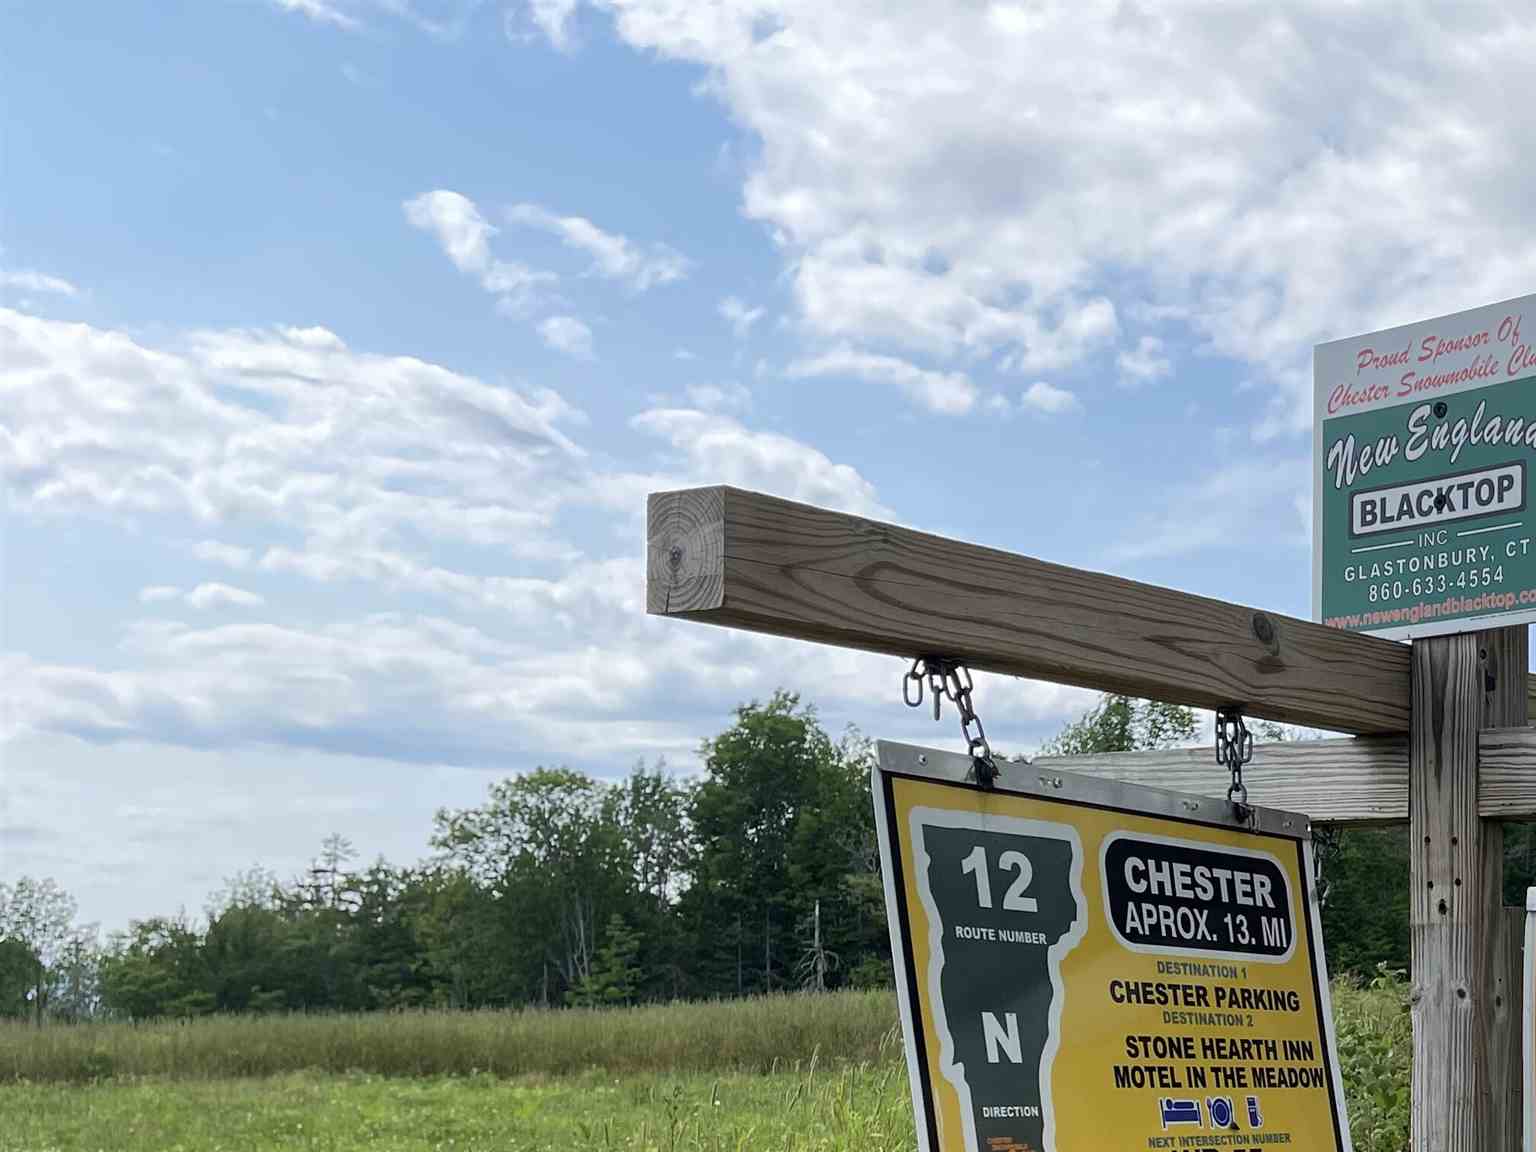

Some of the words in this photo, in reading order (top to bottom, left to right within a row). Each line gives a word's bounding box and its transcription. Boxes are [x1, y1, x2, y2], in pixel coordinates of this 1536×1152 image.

[1357, 341, 1411, 375] Proud
[1418, 330, 1489, 365] Sponsor
[1497, 314, 1522, 346] Of
[1328, 383, 1390, 414] Chester
[1397, 353, 1498, 397] Snowmobile
[1327, 432, 1400, 489] New
[1360, 474, 1514, 527] BLACKTOP
[1417, 530, 1448, 547] INC
[1344, 545, 1495, 582] GLASTONBURY,
[1506, 539, 1530, 557] CT
[1368, 566, 1503, 602] 860-633-4554
[961, 846, 1038, 912] 12
[1124, 856, 1276, 908] CHESTER
[955, 926, 996, 941] ROUTE
[998, 930, 1047, 945] NUMBER
[1125, 901, 1217, 942] APROX.
[1224, 913, 1256, 945] 13.
[1261, 916, 1287, 948] MI
[1157, 960, 1238, 978] DESTINATION
[1241, 967, 1248, 979] 1
[1110, 980, 1210, 1008] CHESTER
[1215, 986, 1300, 1012] PARKING
[1163, 1011, 1243, 1026] DESTINATION
[1246, 1014, 1254, 1027] 2
[981, 1011, 1023, 1064] N
[1126, 1035, 1197, 1059] STONE
[1201, 1038, 1278, 1060] HEARTH
[1283, 1040, 1315, 1061] INN
[1113, 1065, 1182, 1089] MOTEL
[1187, 1067, 1206, 1089] IN
[1210, 1067, 1248, 1088] THE
[1253, 1067, 1324, 1088] MEADOW
[983, 1106, 1039, 1118] DIRECTION
[1149, 1136, 1175, 1148] NEXT
[1179, 1134, 1250, 1147] INTERSECTION
[1252, 1133, 1291, 1143] NUMBER
